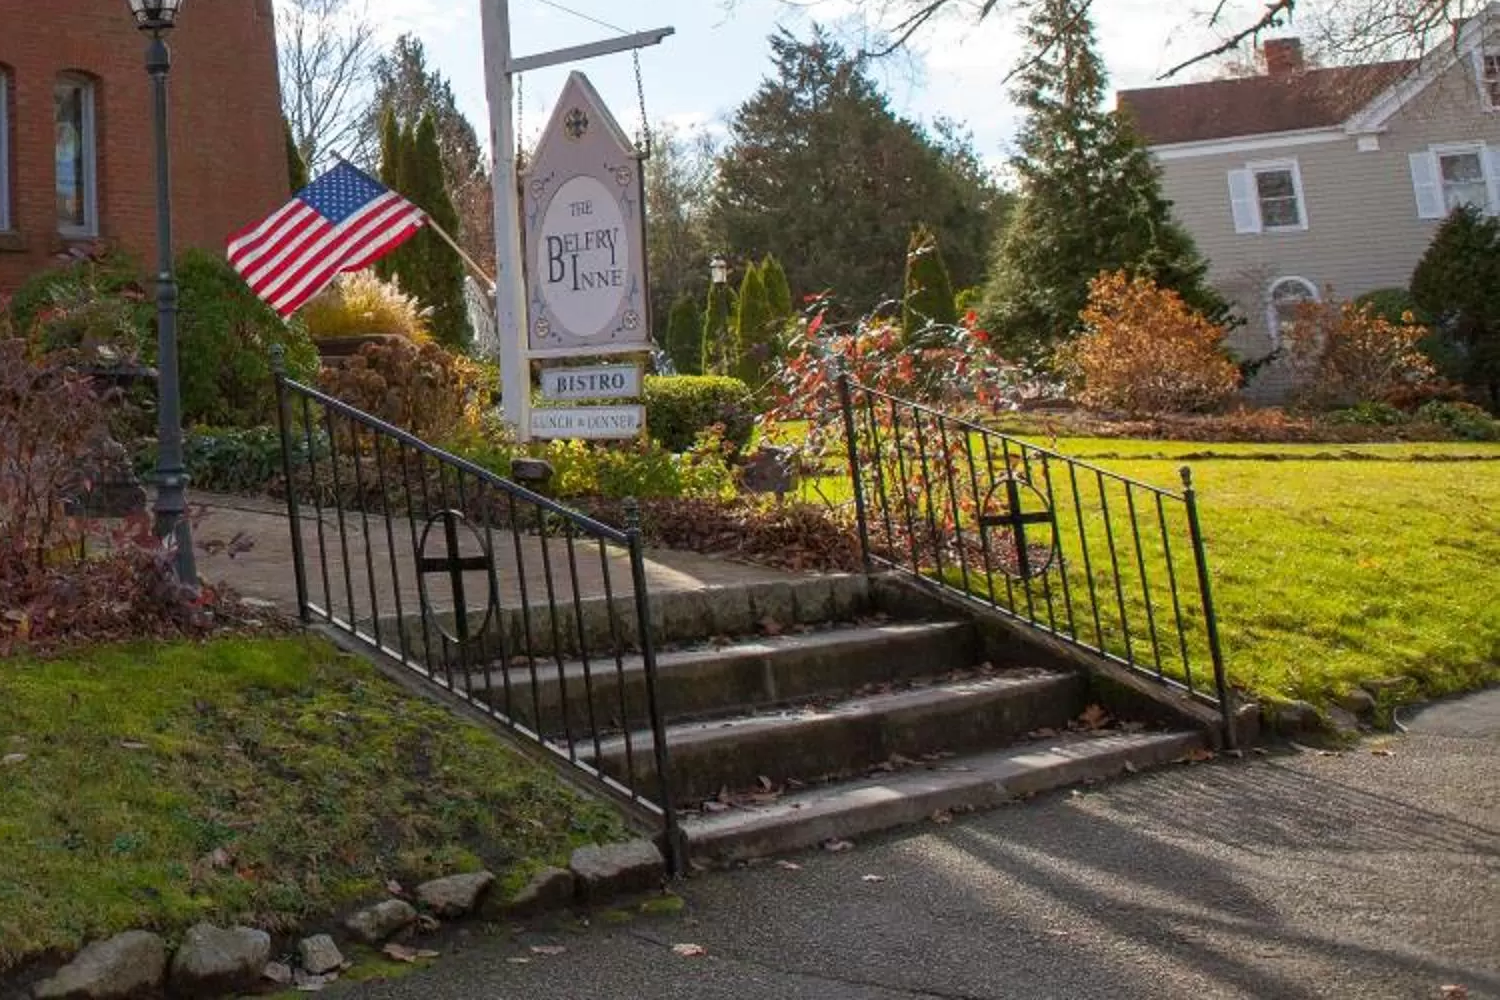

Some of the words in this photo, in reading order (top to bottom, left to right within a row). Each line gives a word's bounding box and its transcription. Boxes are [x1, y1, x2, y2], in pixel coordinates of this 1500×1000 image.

[568, 200, 593, 217] THE
[546, 227, 619, 283] BELFRY
[572, 254, 623, 291] INNE
[557, 373, 625, 393] BISTRO
